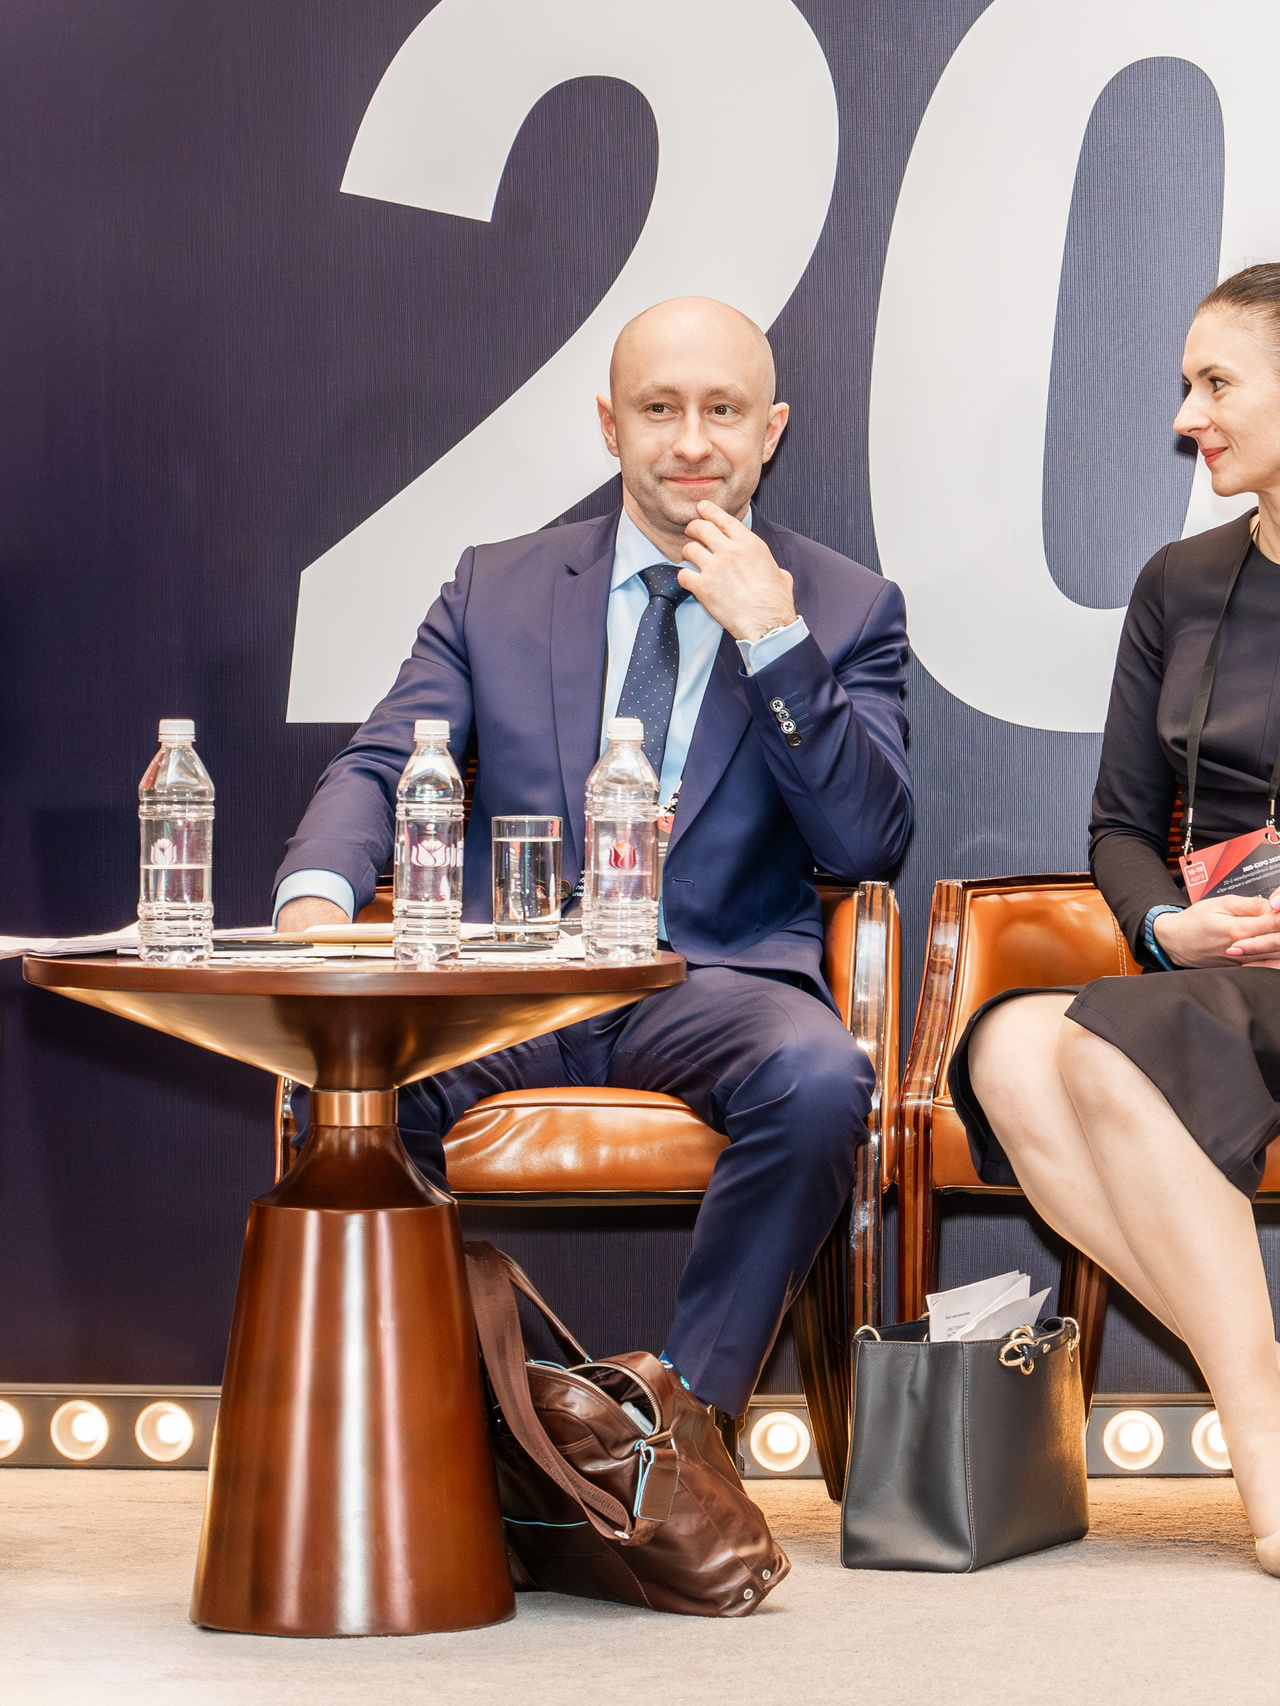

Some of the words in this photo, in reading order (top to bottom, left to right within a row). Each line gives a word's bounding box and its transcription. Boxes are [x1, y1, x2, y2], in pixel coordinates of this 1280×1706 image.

[1187, 866, 1204, 876] 16-18
[1242, 859, 1269, 873] MIR-EXPO
[1191, 873, 1205, 882] April
